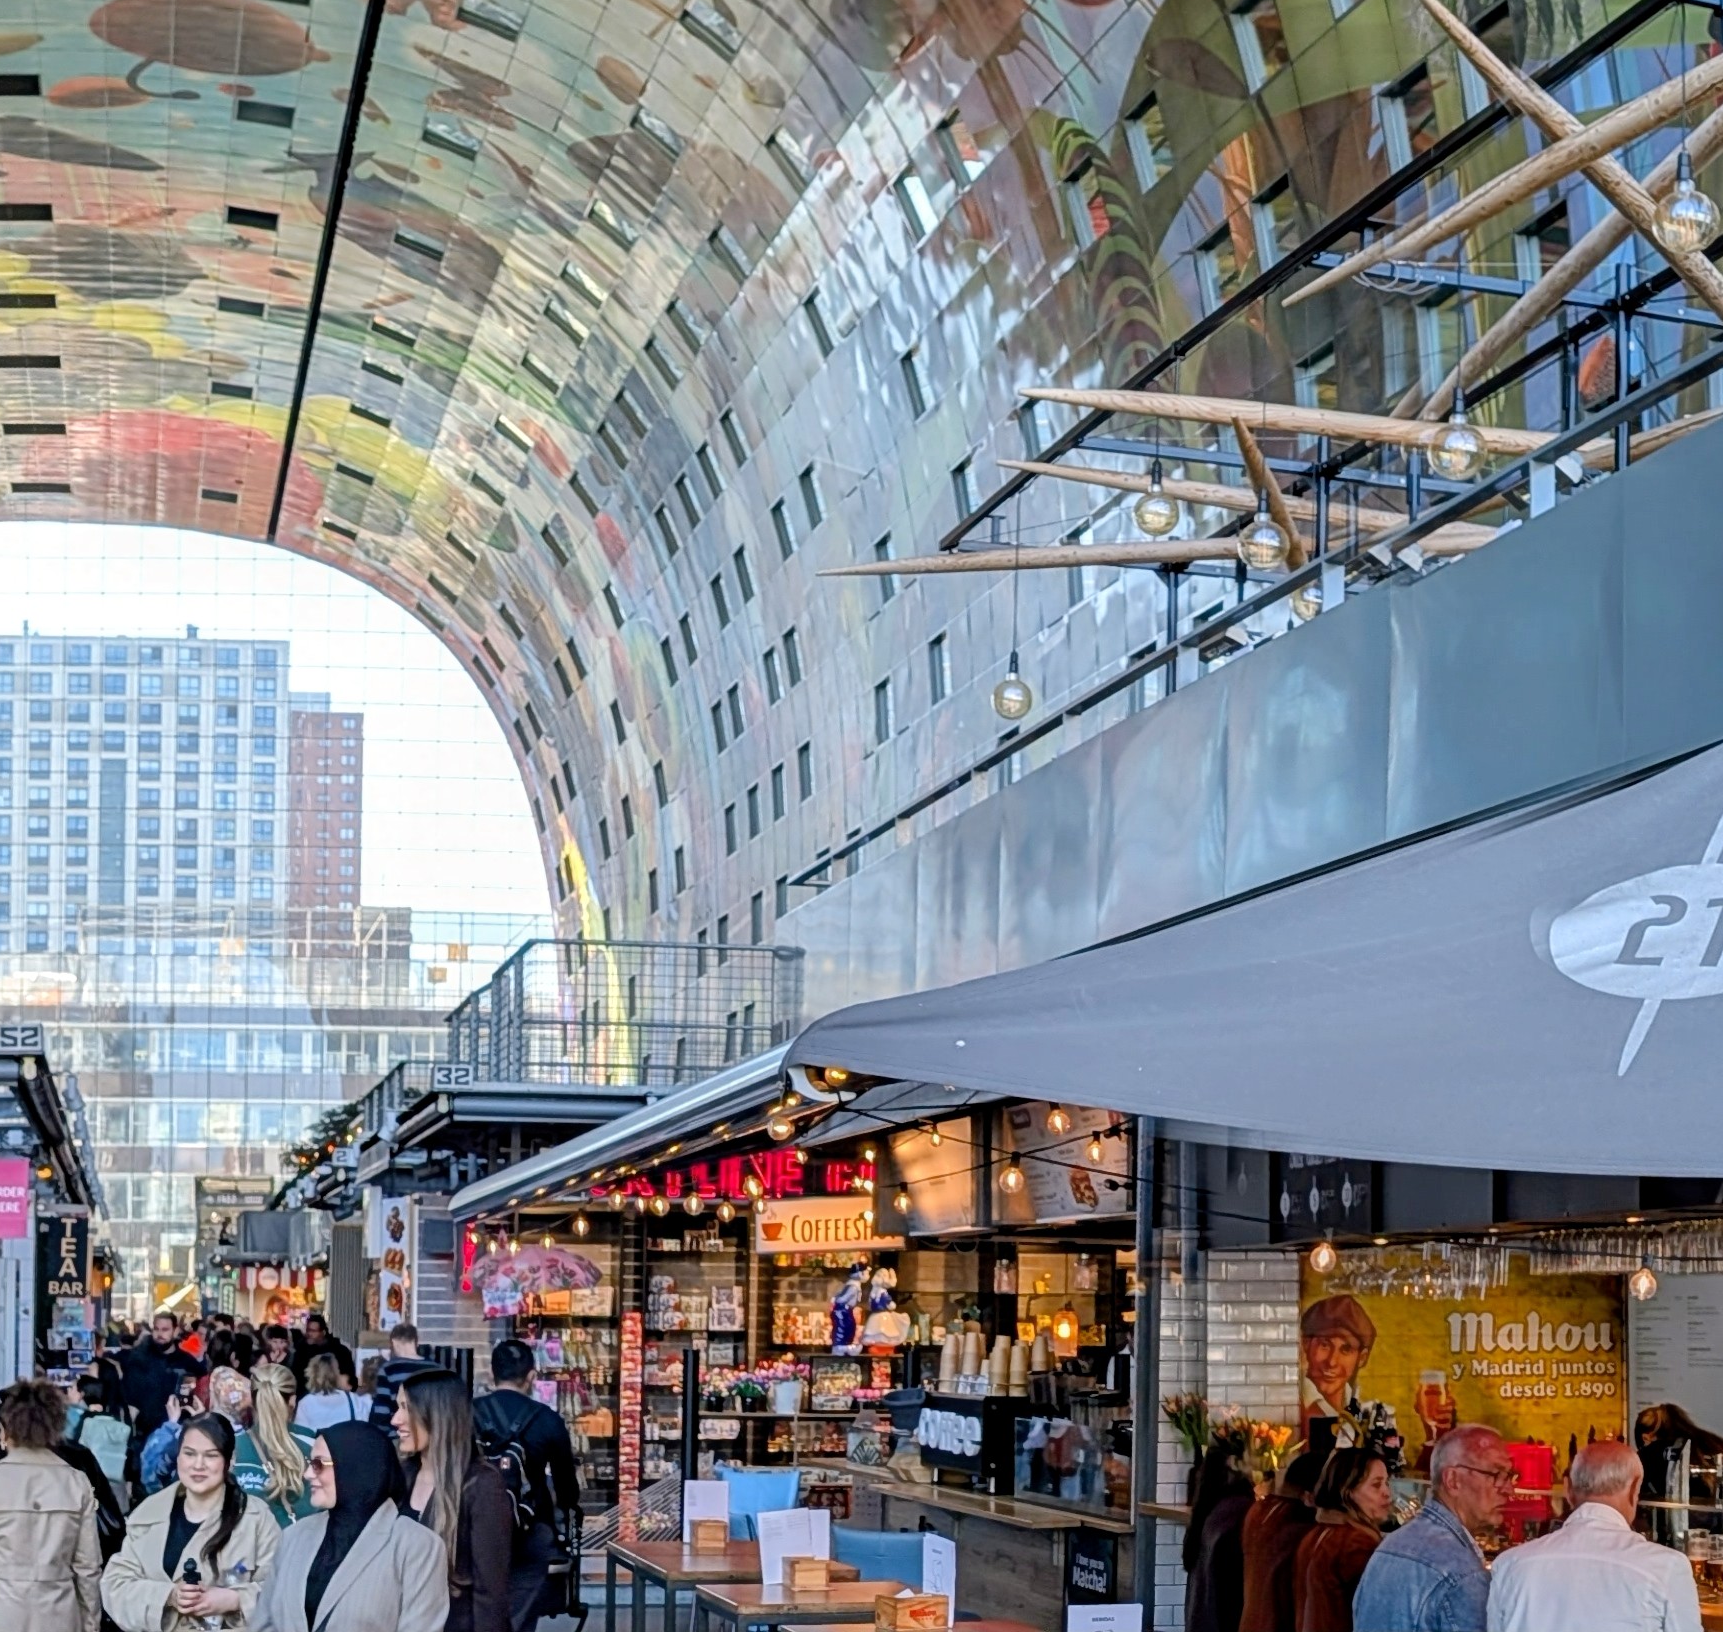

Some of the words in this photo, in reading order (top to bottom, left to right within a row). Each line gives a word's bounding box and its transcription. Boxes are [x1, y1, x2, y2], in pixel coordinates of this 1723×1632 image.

[0, 1027, 38, 1047] 52
[437, 1068, 470, 1086] 32
[791, 1214, 896, 1242] COFFEESH
[60, 1218, 78, 1278] TEA
[48, 1281, 84, 1295] BAR
[1447, 1310, 1614, 1353] Mahou
[1452, 1362, 1465, 1380] y
[1471, 1359, 1545, 1376] Madrid
[1551, 1360, 1616, 1378] juntos
[1499, 1381, 1557, 1398] desde
[1563, 1382, 1615, 1398] 1.890
[1072, 1567, 1107, 1593] Matcha!
